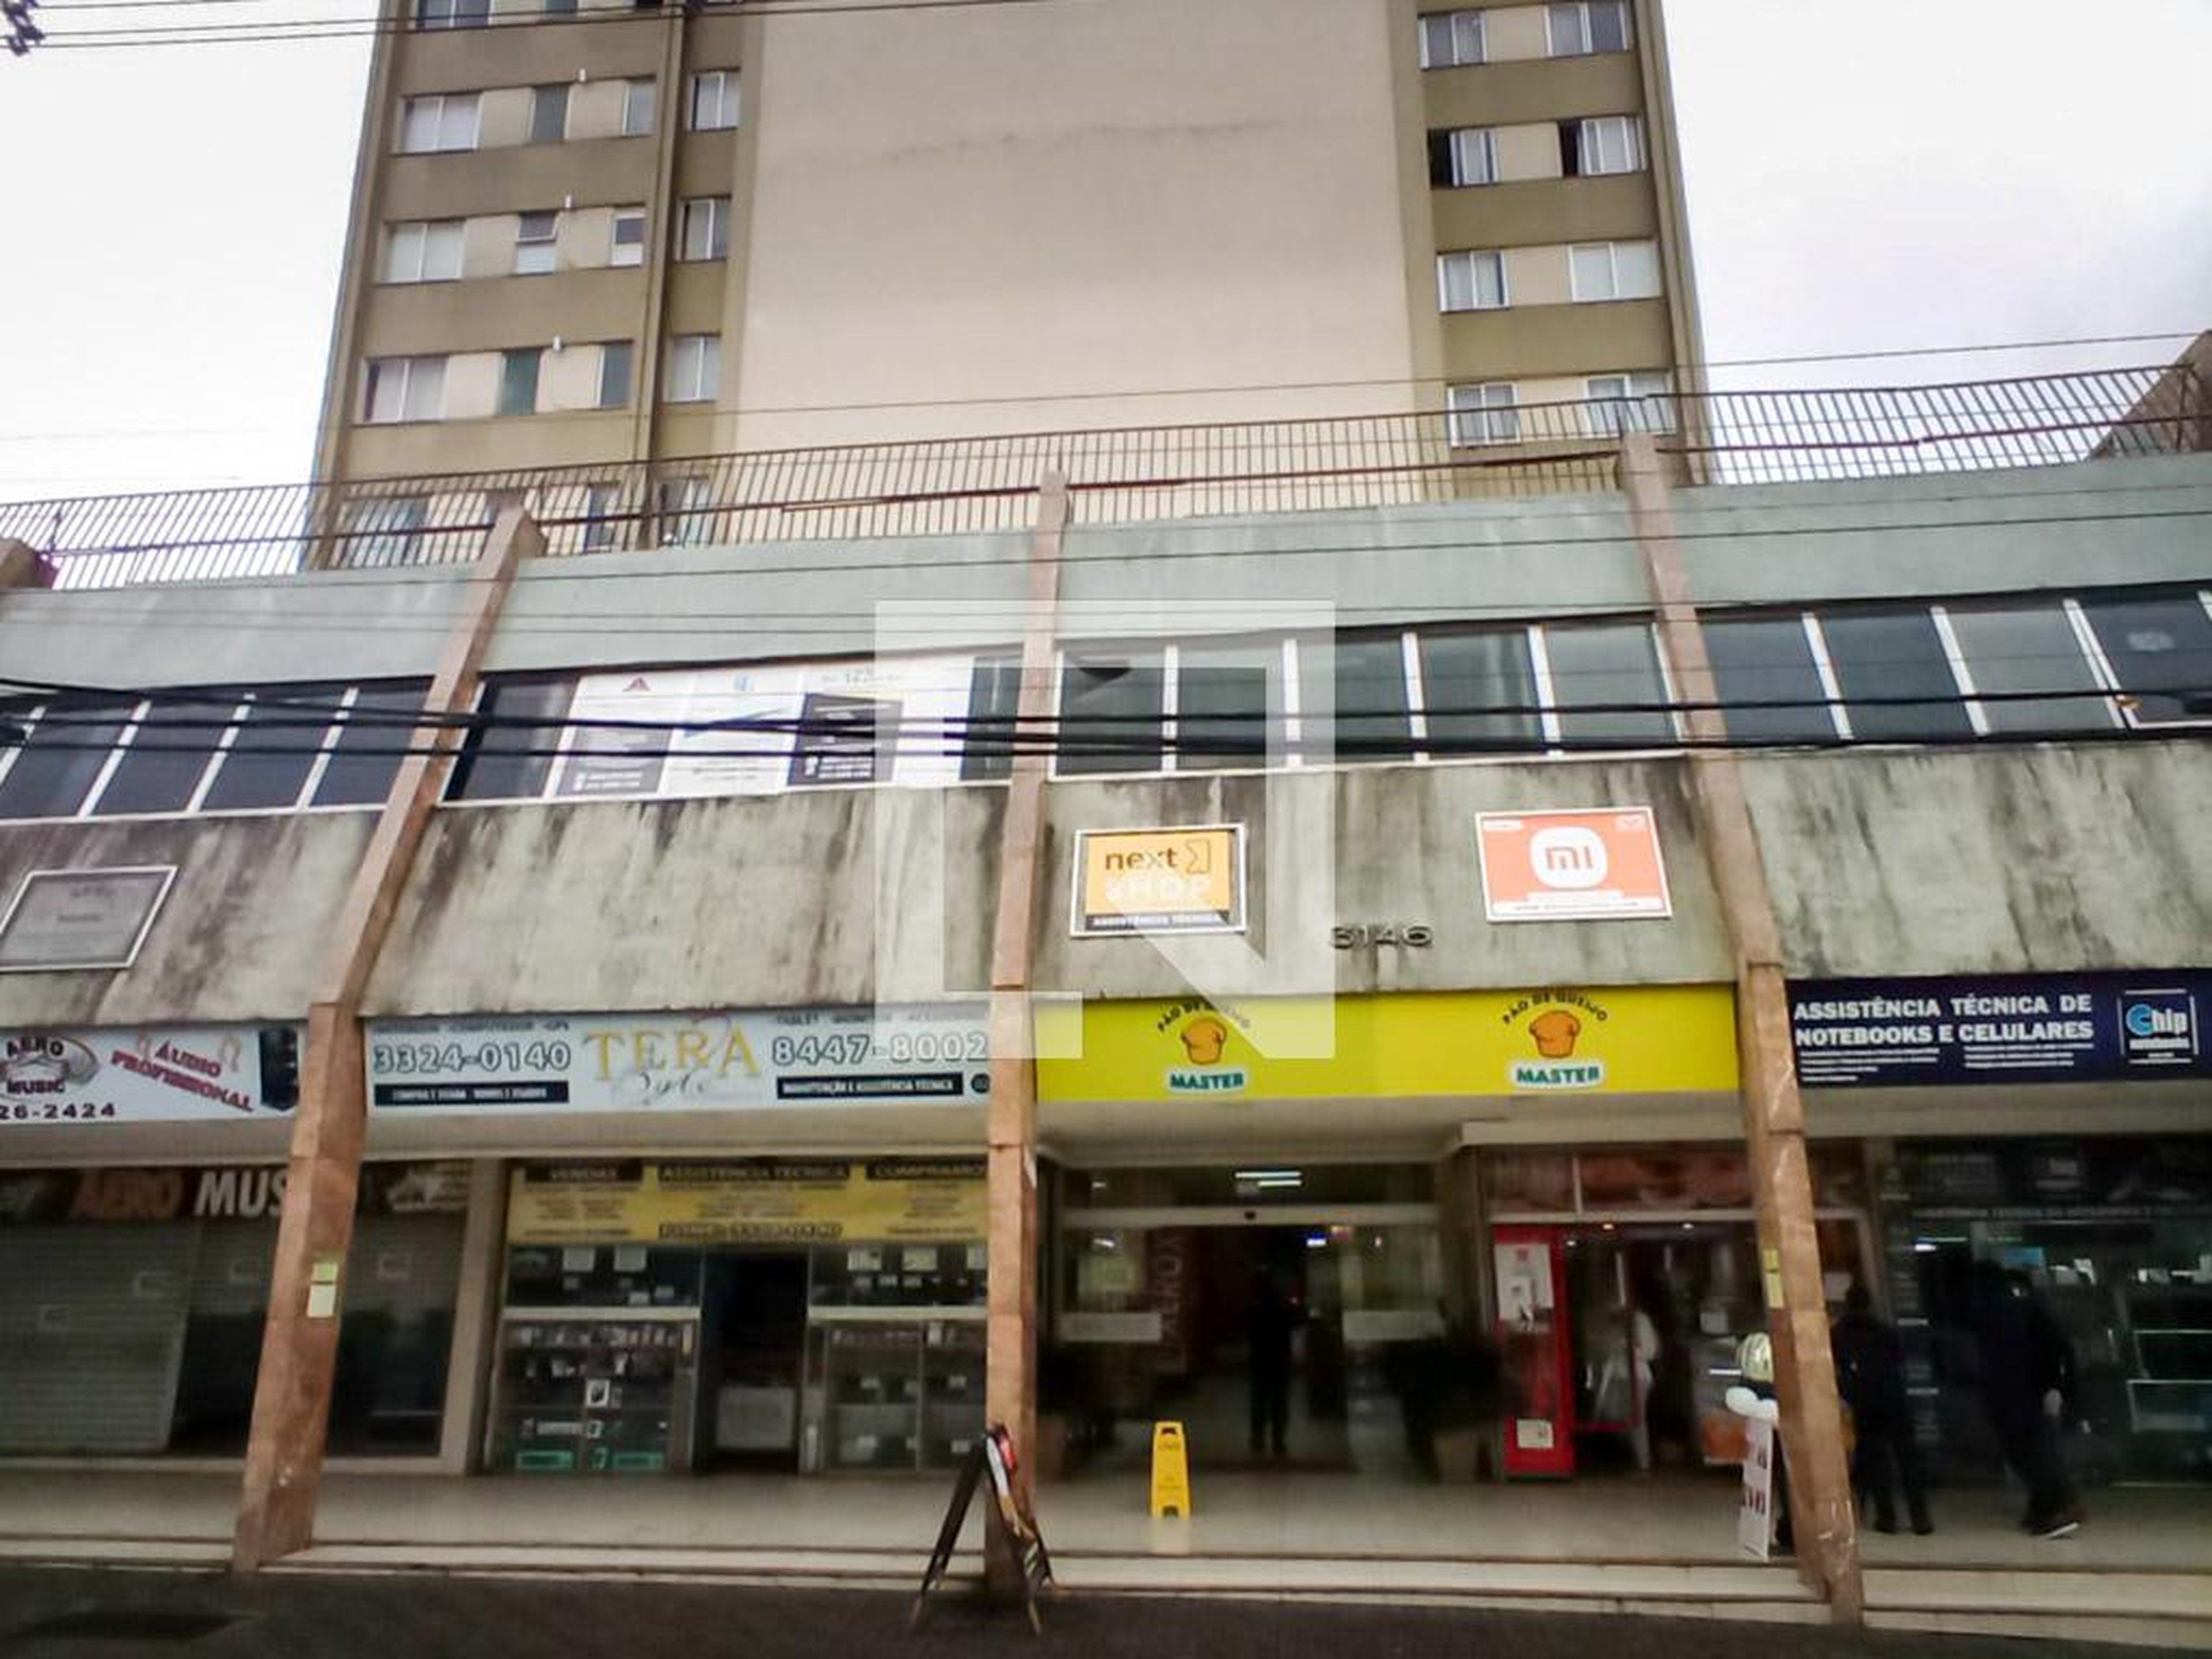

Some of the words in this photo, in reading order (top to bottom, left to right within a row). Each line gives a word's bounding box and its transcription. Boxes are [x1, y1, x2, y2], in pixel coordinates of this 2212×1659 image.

[1105, 847, 1177, 870] next
[1794, 995, 1941, 1020] ASSISTÊNCIA
[1950, 992, 2050, 1016] TÉCNICA
[2059, 994, 2092, 1013] DE
[2126, 1003, 2187, 1036] Chip
[1795, 1025, 1933, 1047] NOTEBOOKS
[1938, 1024, 1954, 1043] E
[1959, 1021, 2094, 1043] CELULARES
[373, 1041, 572, 1074] 3324-0140
[581, 1018, 762, 1081] TERA
[772, 1032, 987, 1066] 8447-8002
[7, 1077, 66, 1094] MUSIC
[1170, 1073, 1244, 1089] MASTER
[1517, 1066, 1600, 1084] MASTER
